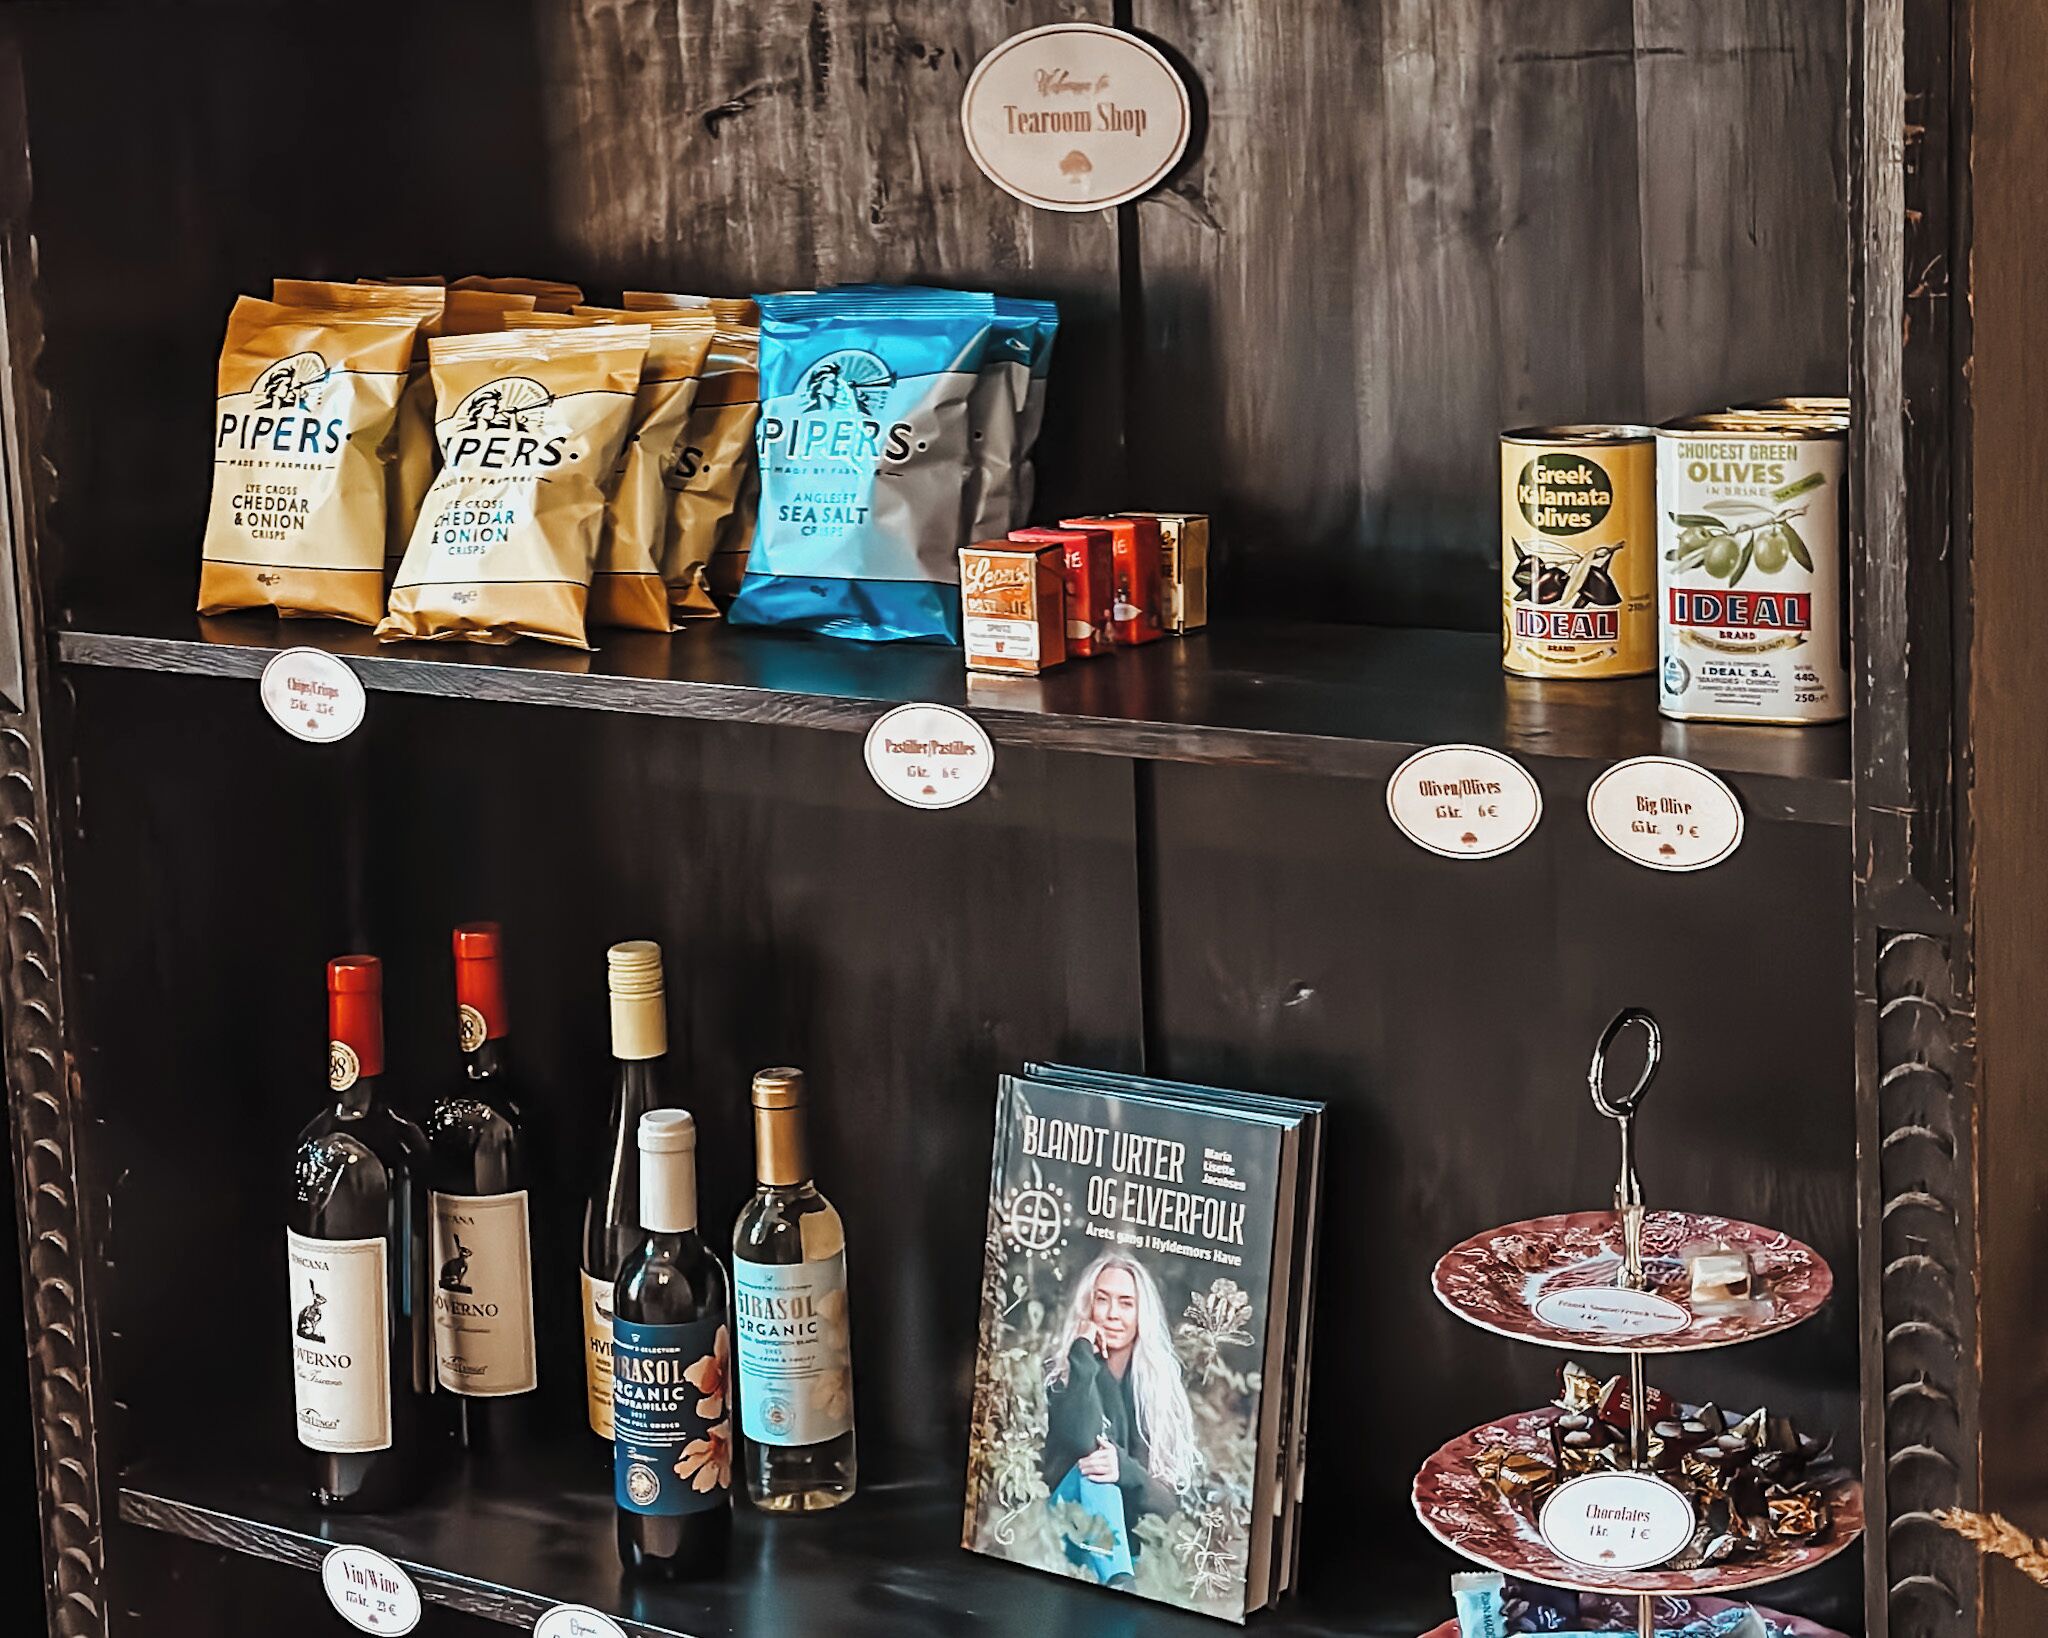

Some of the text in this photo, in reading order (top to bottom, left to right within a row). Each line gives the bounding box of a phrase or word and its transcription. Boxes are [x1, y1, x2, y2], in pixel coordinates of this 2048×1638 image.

[1003, 102, 1147, 137] Tearoom Shop
[1677, 442, 1798, 462] CHOICEST GREEN
[1532, 464, 1593, 486] Greek
[1687, 461, 1785, 485] OLIVES
[265, 485, 298, 496] CROSS
[1519, 484, 1611, 507] Kalamata
[232, 494, 310, 513] CHEDDAR
[234, 512, 305, 530] & ONION
[778, 504, 869, 525] SEA SALT
[1535, 507, 1592, 528] olives
[251, 529, 286, 540] CRISPS
[444, 527, 509, 543] ONION
[448, 545, 486, 556] CRISPS
[1675, 592, 1807, 628] IDEAL
[1516, 608, 1617, 639] IDEAL
[1719, 630, 1757, 640] BRAND
[1702, 666, 1776, 679] IDEAL S.A.
[1419, 779, 1503, 799] Oliven/Olives
[1487, 804, 1500, 818] €
[1636, 795, 1693, 816] Big Olive
[1689, 826, 1701, 838] €
[1022, 1114, 1186, 1184] BLANDT URTER
[1087, 1175, 1246, 1246] OG ELVERFOLK
[1212, 1249, 1243, 1267] Have
[1586, 1503, 1651, 1523] Chocolates
[1640, 1528, 1652, 1541] €
[343, 1560, 400, 1596] Vin/Wine
[388, 1604, 398, 1617] €
